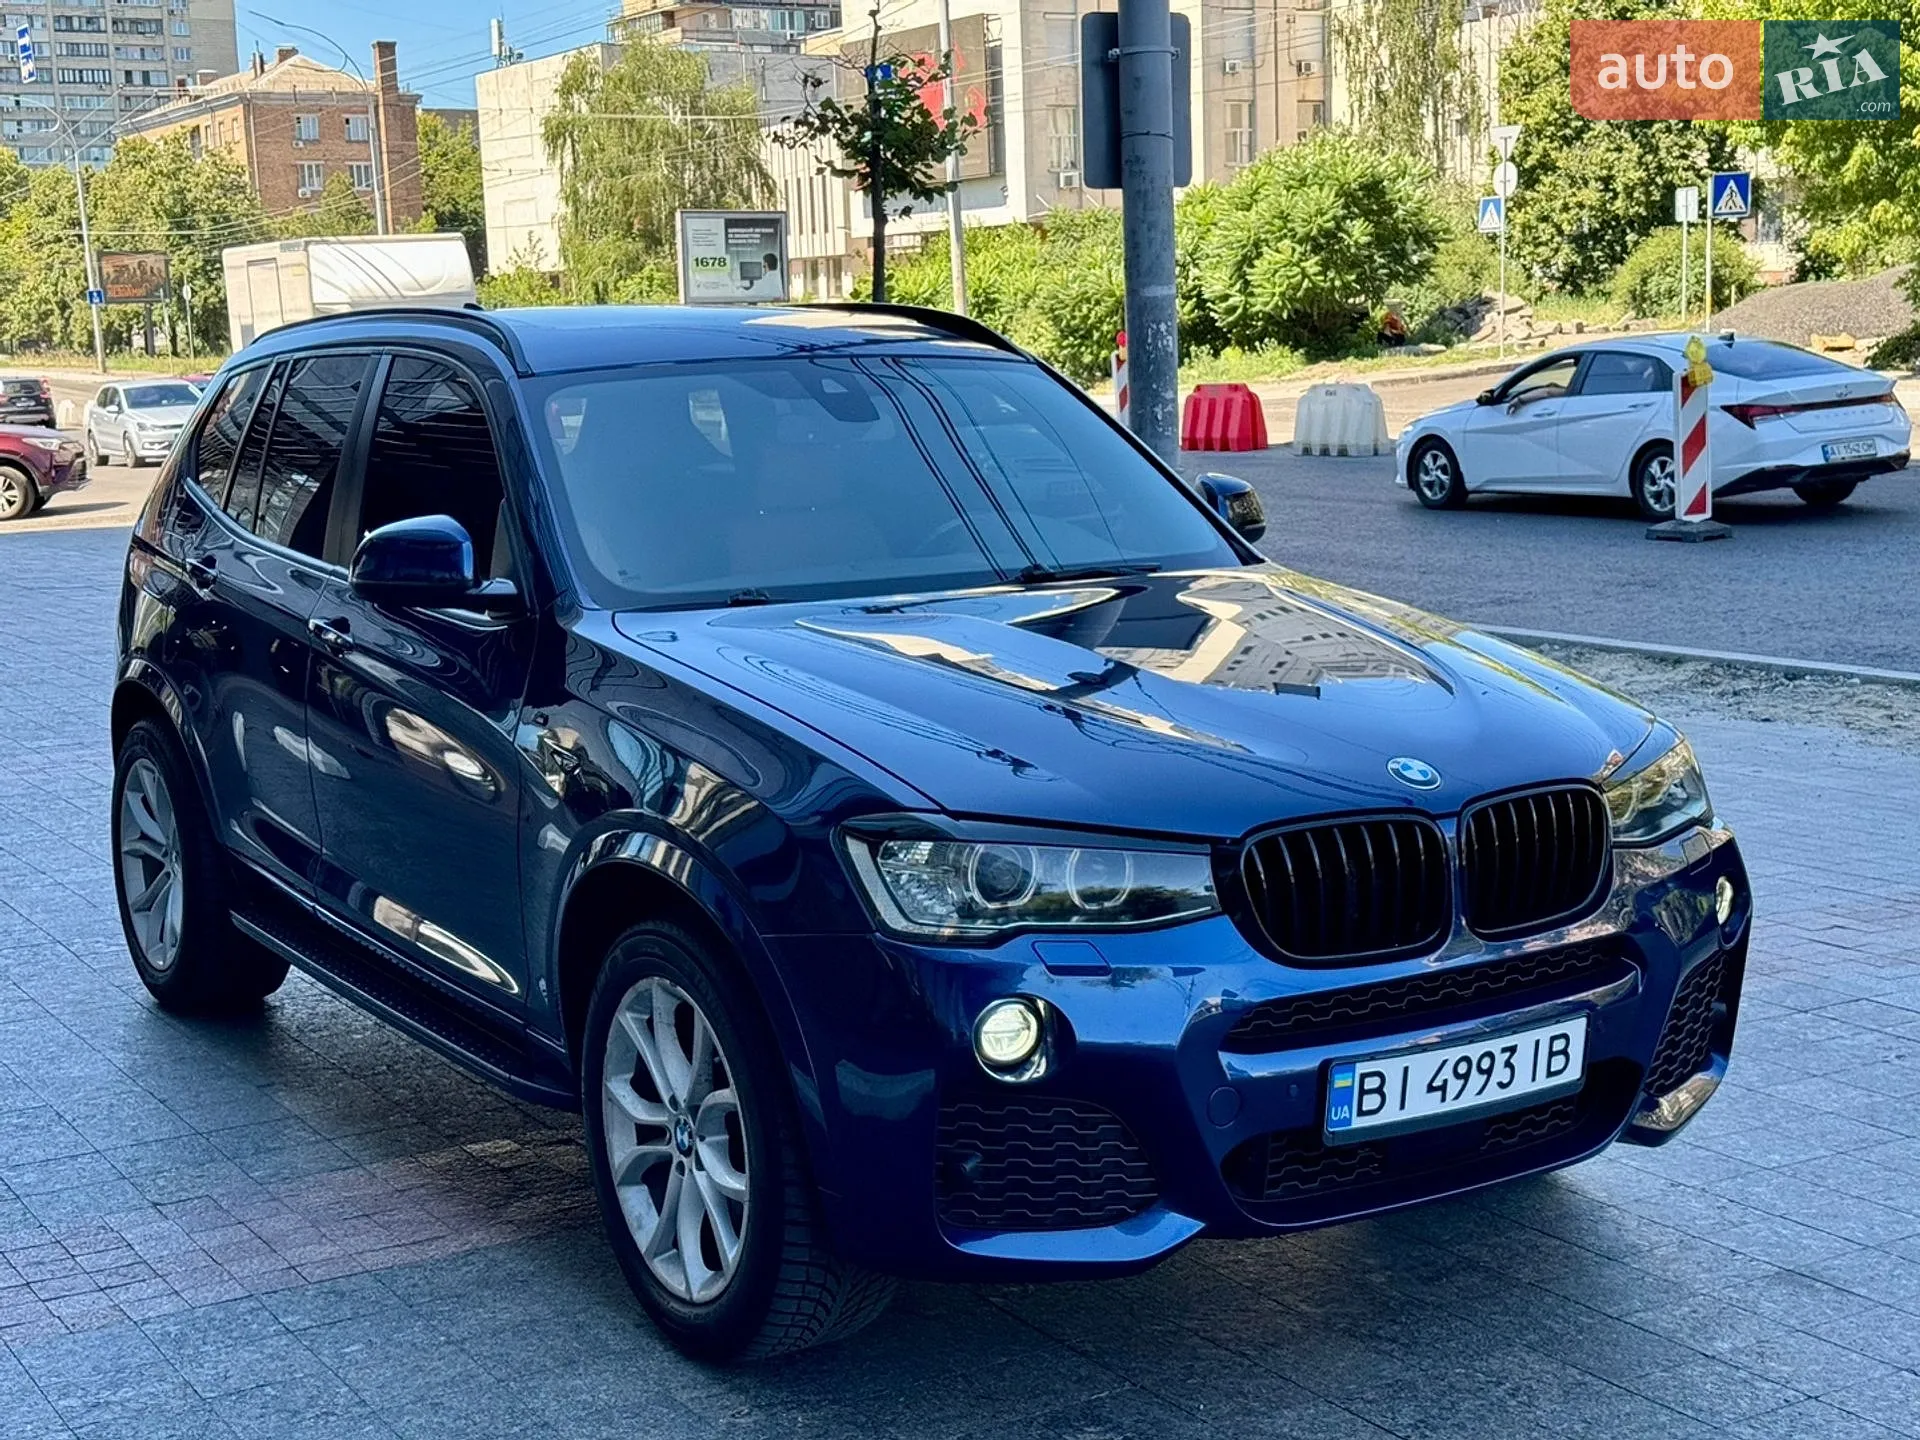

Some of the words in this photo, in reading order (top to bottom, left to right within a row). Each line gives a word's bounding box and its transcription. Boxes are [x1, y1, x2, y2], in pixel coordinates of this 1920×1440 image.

[694, 256, 728, 268] 1678
[1356, 1066, 1409, 1118] BI
[1426, 1044, 1519, 1104] 4993
[1531, 1032, 1571, 1082] IB
[1331, 1105, 1350, 1121] UA
